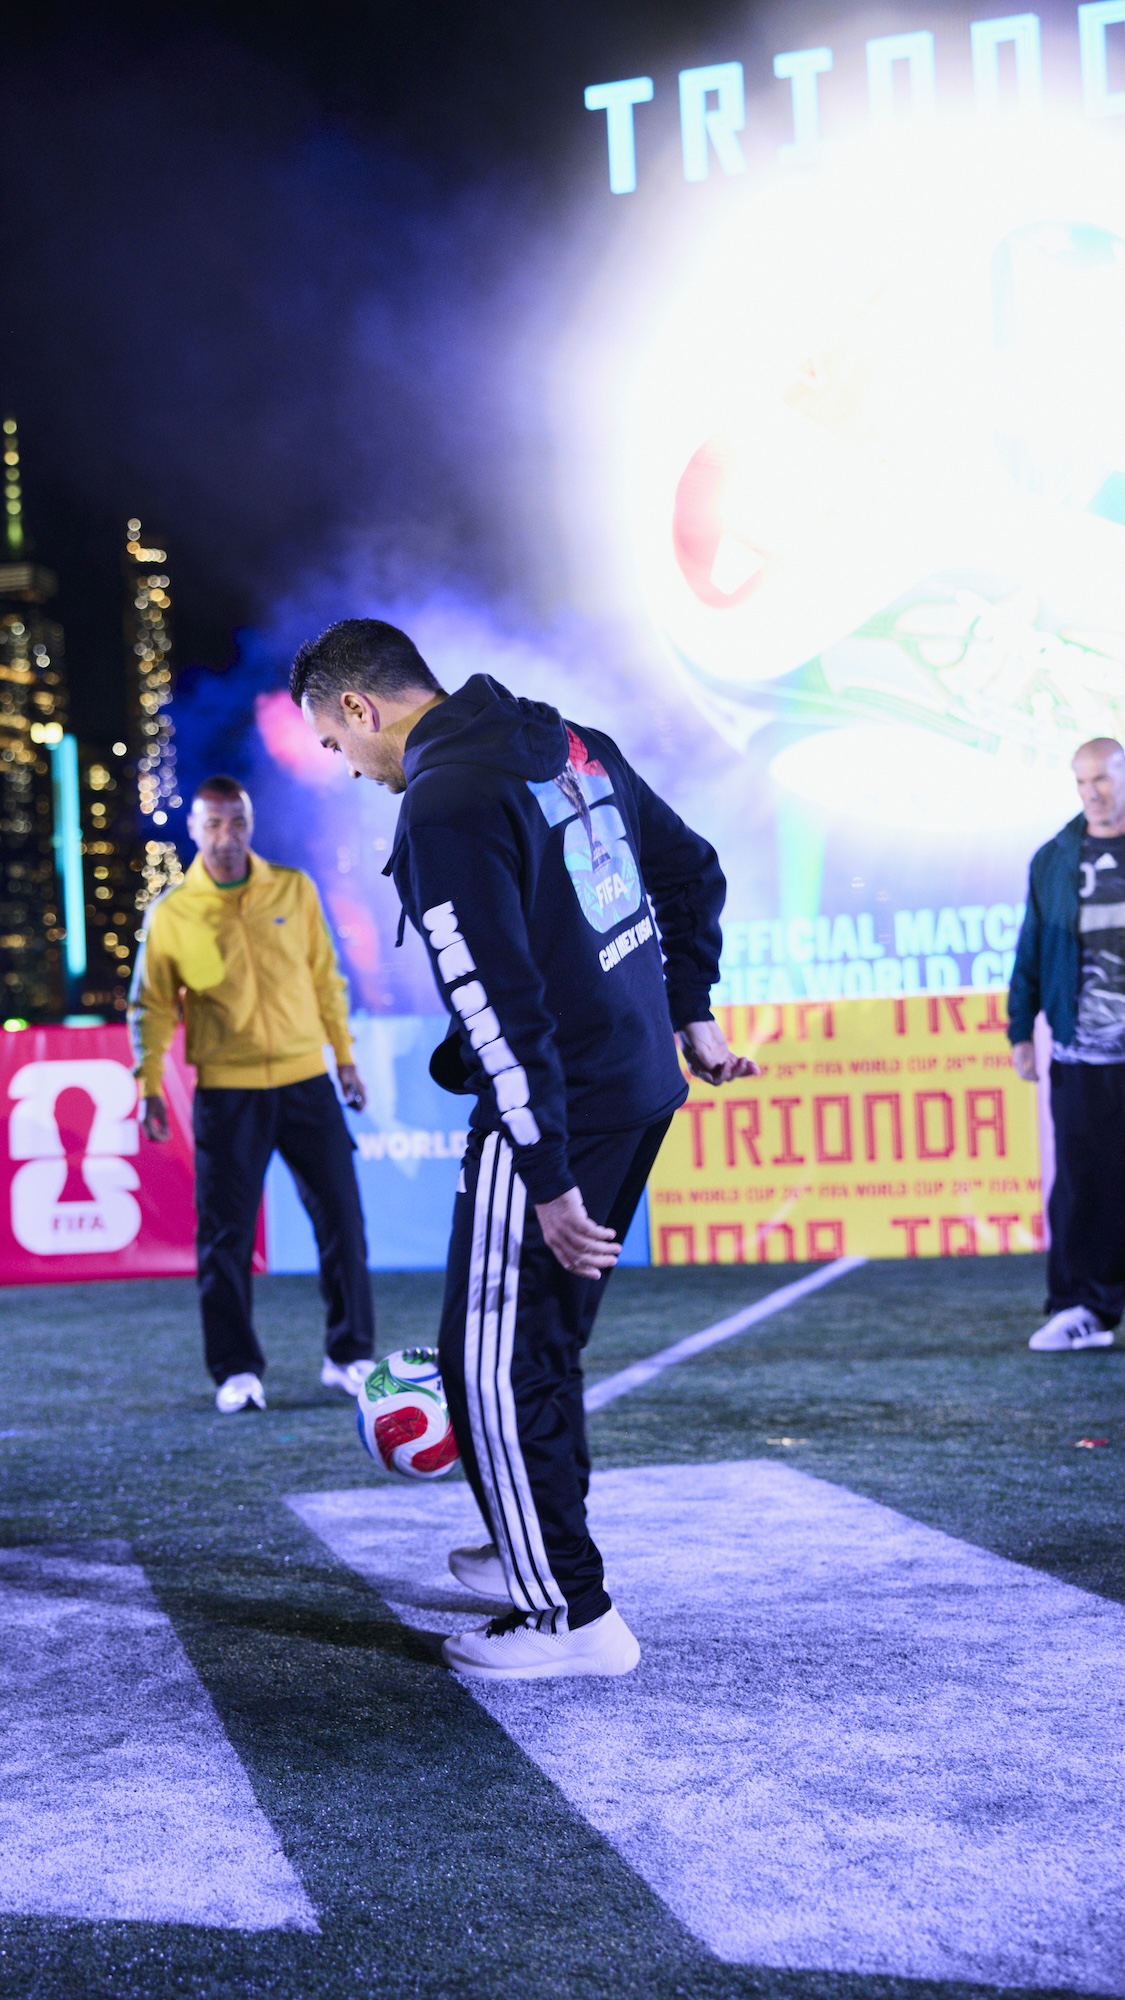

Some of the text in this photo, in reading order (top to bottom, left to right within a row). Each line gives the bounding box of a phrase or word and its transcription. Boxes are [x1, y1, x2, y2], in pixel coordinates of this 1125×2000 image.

[595, 872, 629, 909] FIFA
[422, 900, 478, 984] WE
[598, 915, 654, 973] CAN MEX USA
[719, 911, 886, 967] FFICIAL
[801, 955, 961, 1000] WORLD
[850, 1059, 901, 1074] WORLD
[907, 1057, 938, 1072] CUP
[677, 1088, 1006, 1169] TRIONDA
[690, 1187, 740, 1203] WORLD
[855, 1182, 907, 1197] WORLD
[51, 1213, 106, 1234] FIFA
